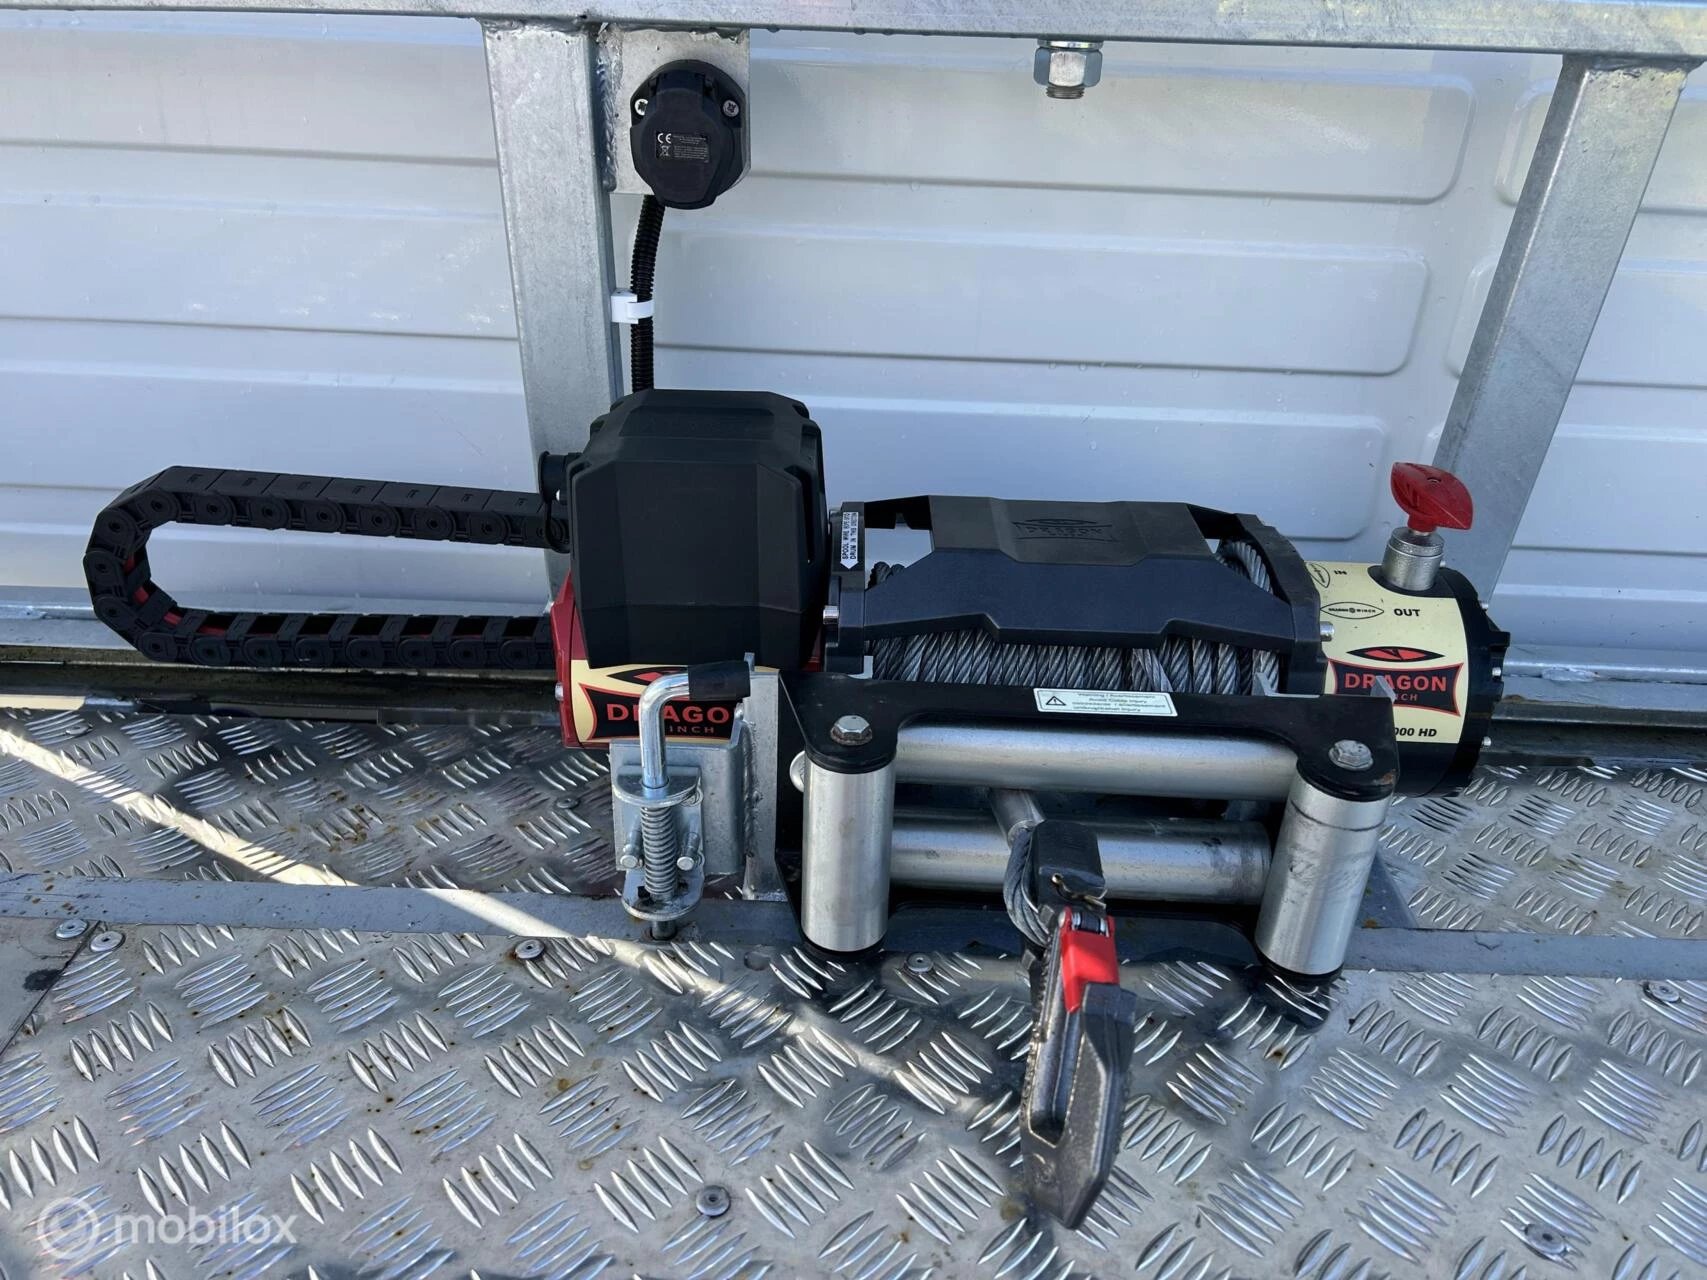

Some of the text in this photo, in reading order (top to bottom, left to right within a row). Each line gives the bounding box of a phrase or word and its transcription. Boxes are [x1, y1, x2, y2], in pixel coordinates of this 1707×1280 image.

[657, 132, 672, 144] CE
[1393, 608, 1421, 617] OUT
[606, 703, 735, 724] DAGO
[669, 725, 715, 734] INCH
[1418, 728, 1438, 737] HD
